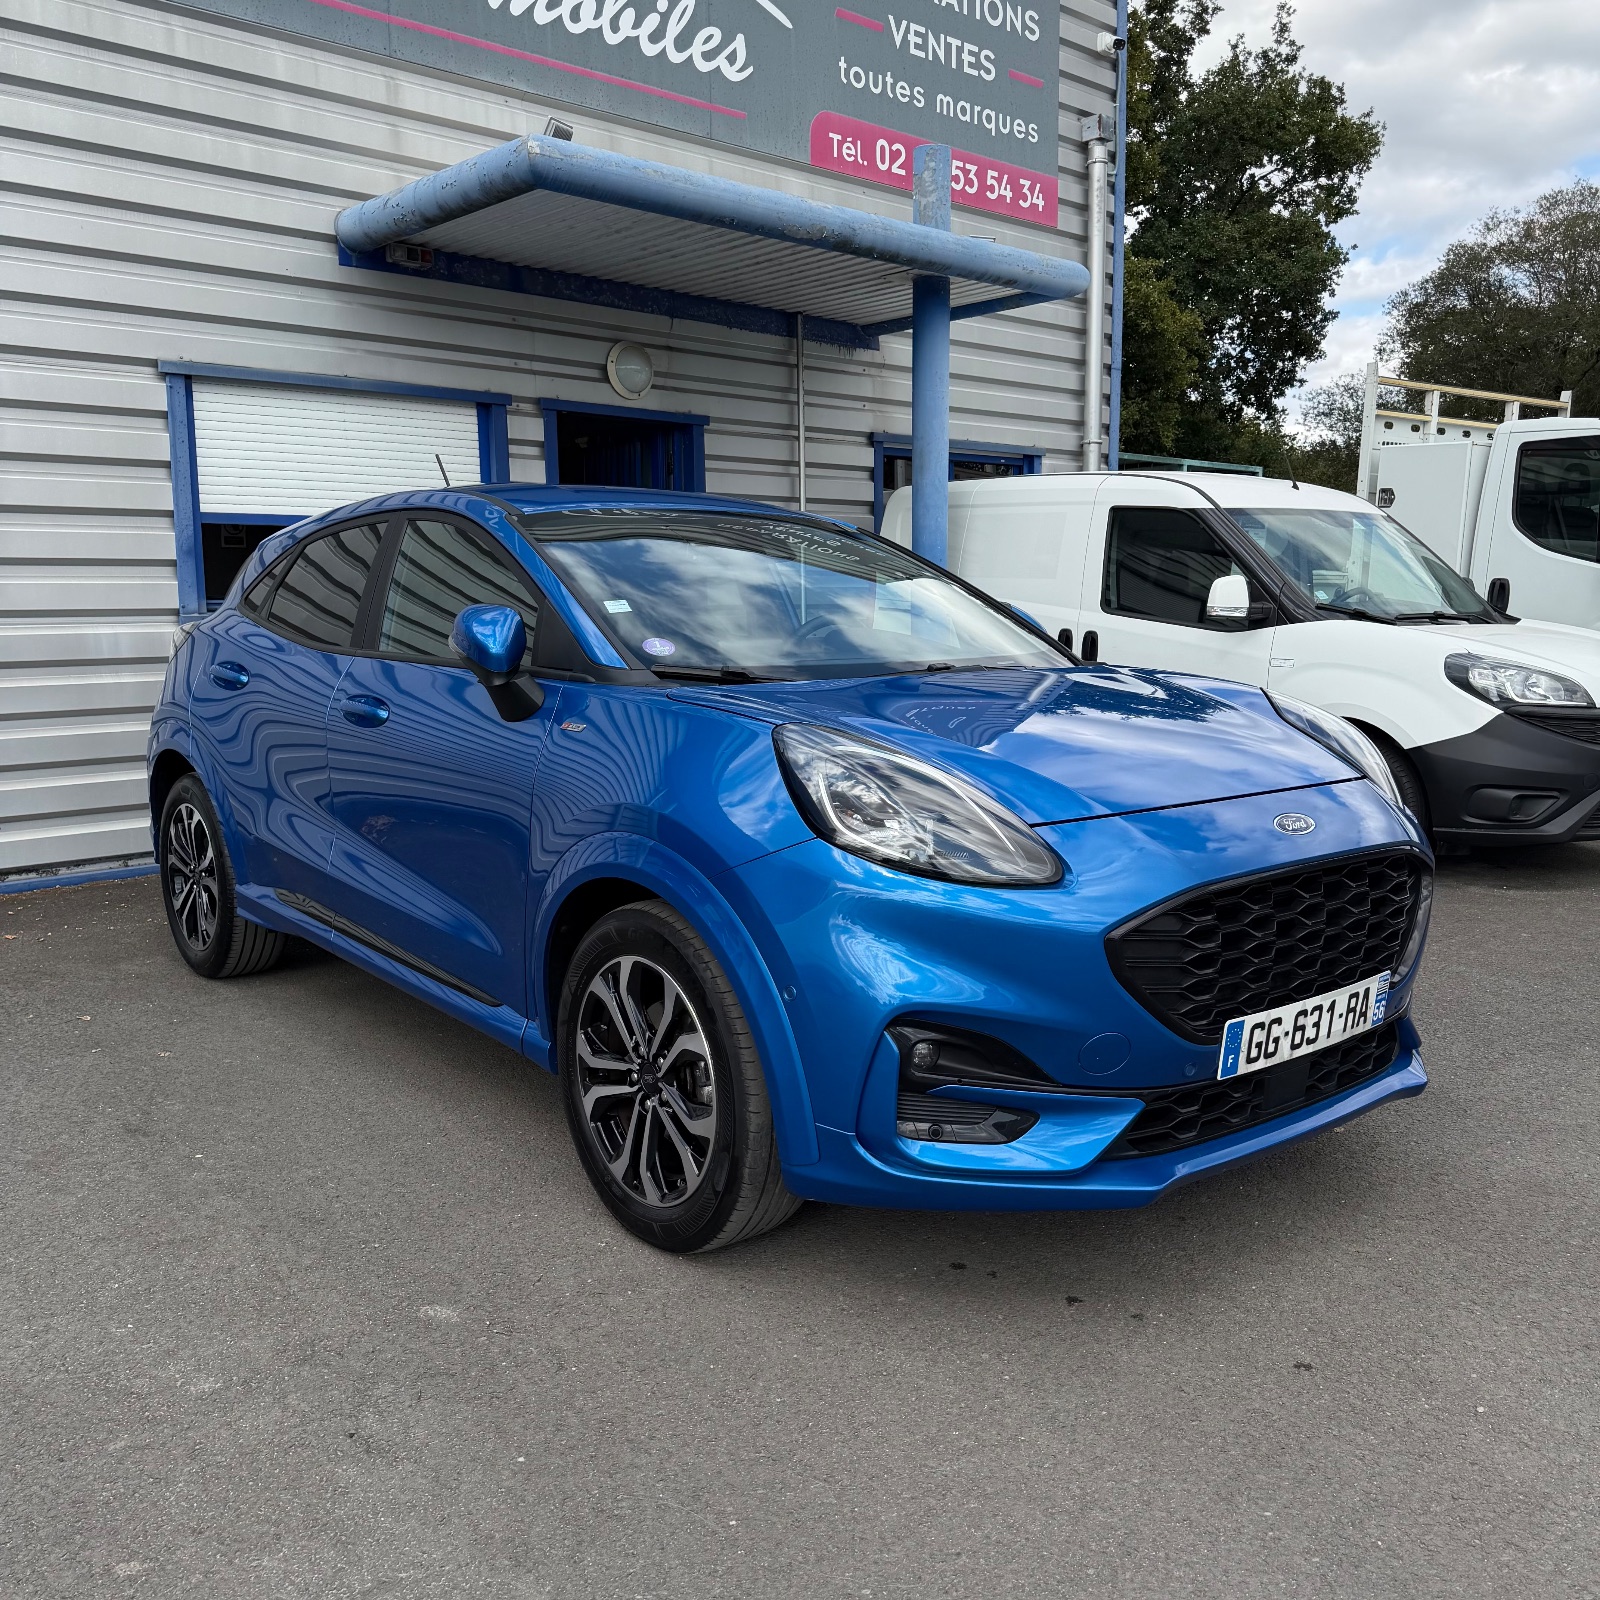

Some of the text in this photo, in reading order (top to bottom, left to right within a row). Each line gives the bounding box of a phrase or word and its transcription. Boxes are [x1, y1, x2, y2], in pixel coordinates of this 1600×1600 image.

[888, 14, 996, 82] VENTES
[838, 56, 1039, 143] toutes marques
[828, 132, 1045, 212] Tél. 02 53 54 34
[1245, 986, 1372, 1065] GG-631-RA
[1372, 1000, 1386, 1021] 56
[1227, 1055, 1235, 1068] F
